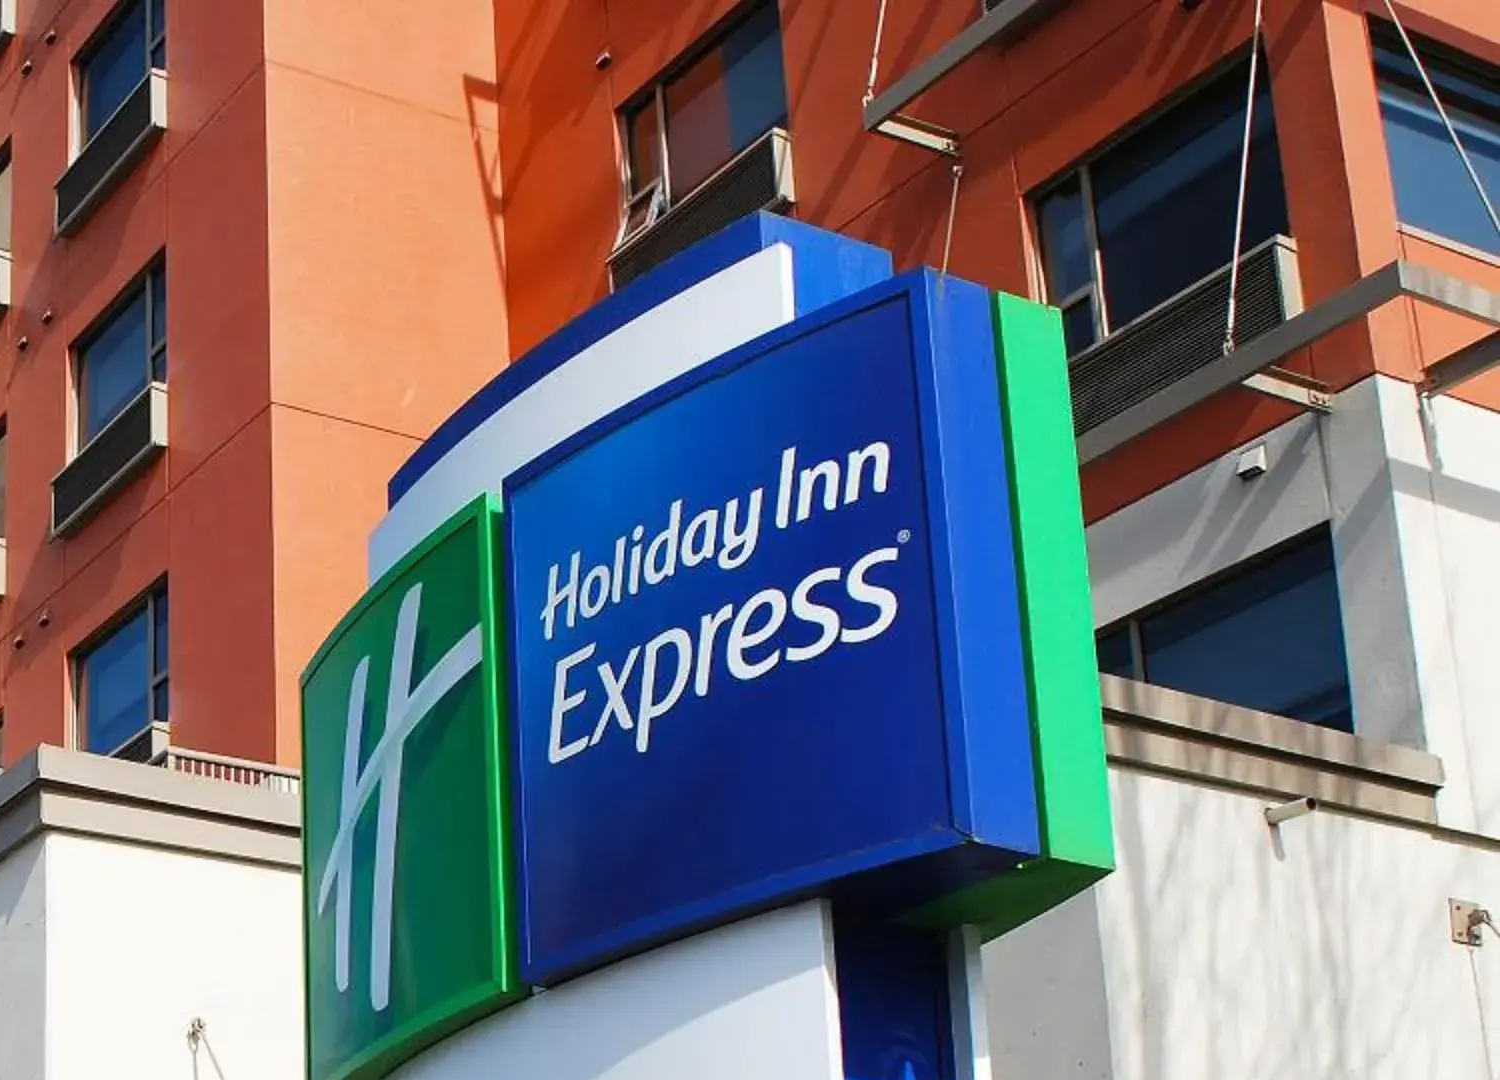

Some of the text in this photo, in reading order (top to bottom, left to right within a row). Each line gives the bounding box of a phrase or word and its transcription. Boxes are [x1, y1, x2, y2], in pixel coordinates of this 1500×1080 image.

[540, 440, 892, 640] Holiday Inn
[548, 547, 899, 764] Express
